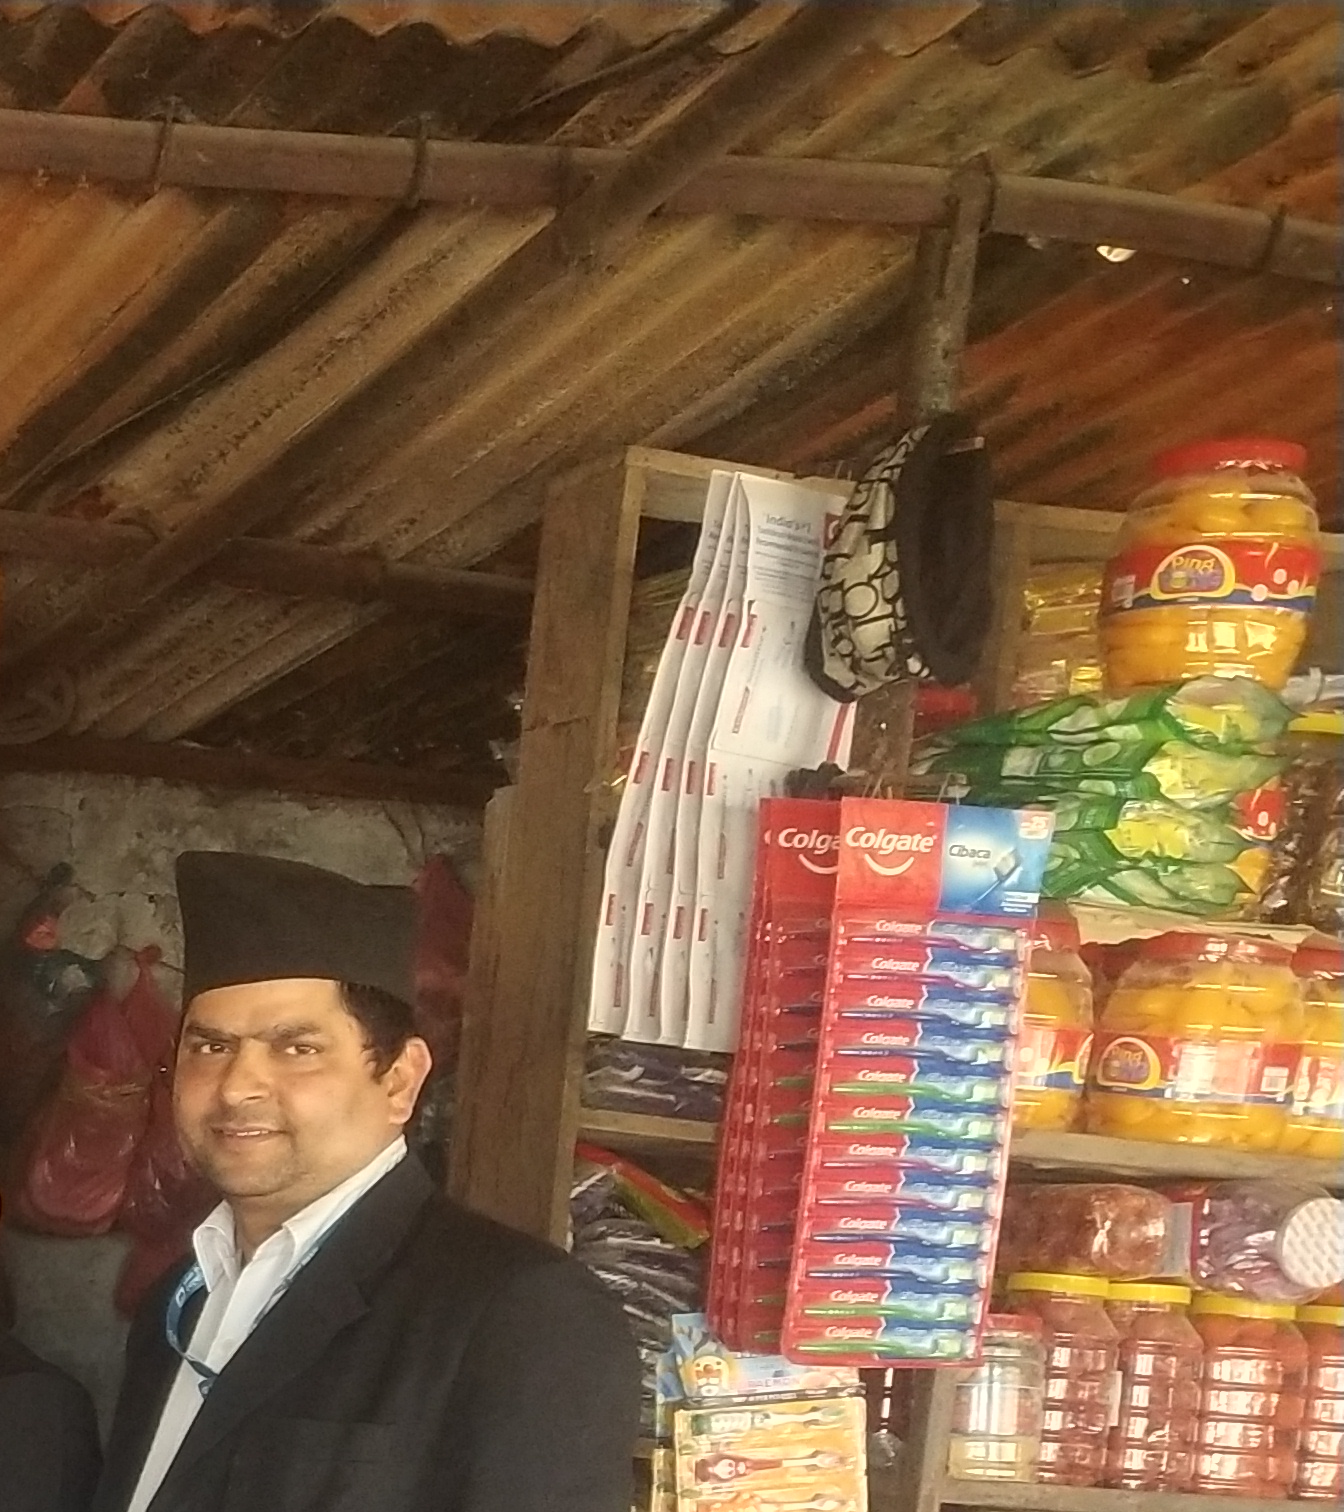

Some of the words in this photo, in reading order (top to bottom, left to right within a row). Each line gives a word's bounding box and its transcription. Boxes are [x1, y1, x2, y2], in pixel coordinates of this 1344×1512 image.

[778, 827, 841, 857] Colga
[845, 825, 936, 857] Colgate
[949, 844, 992, 860] Cibaca
